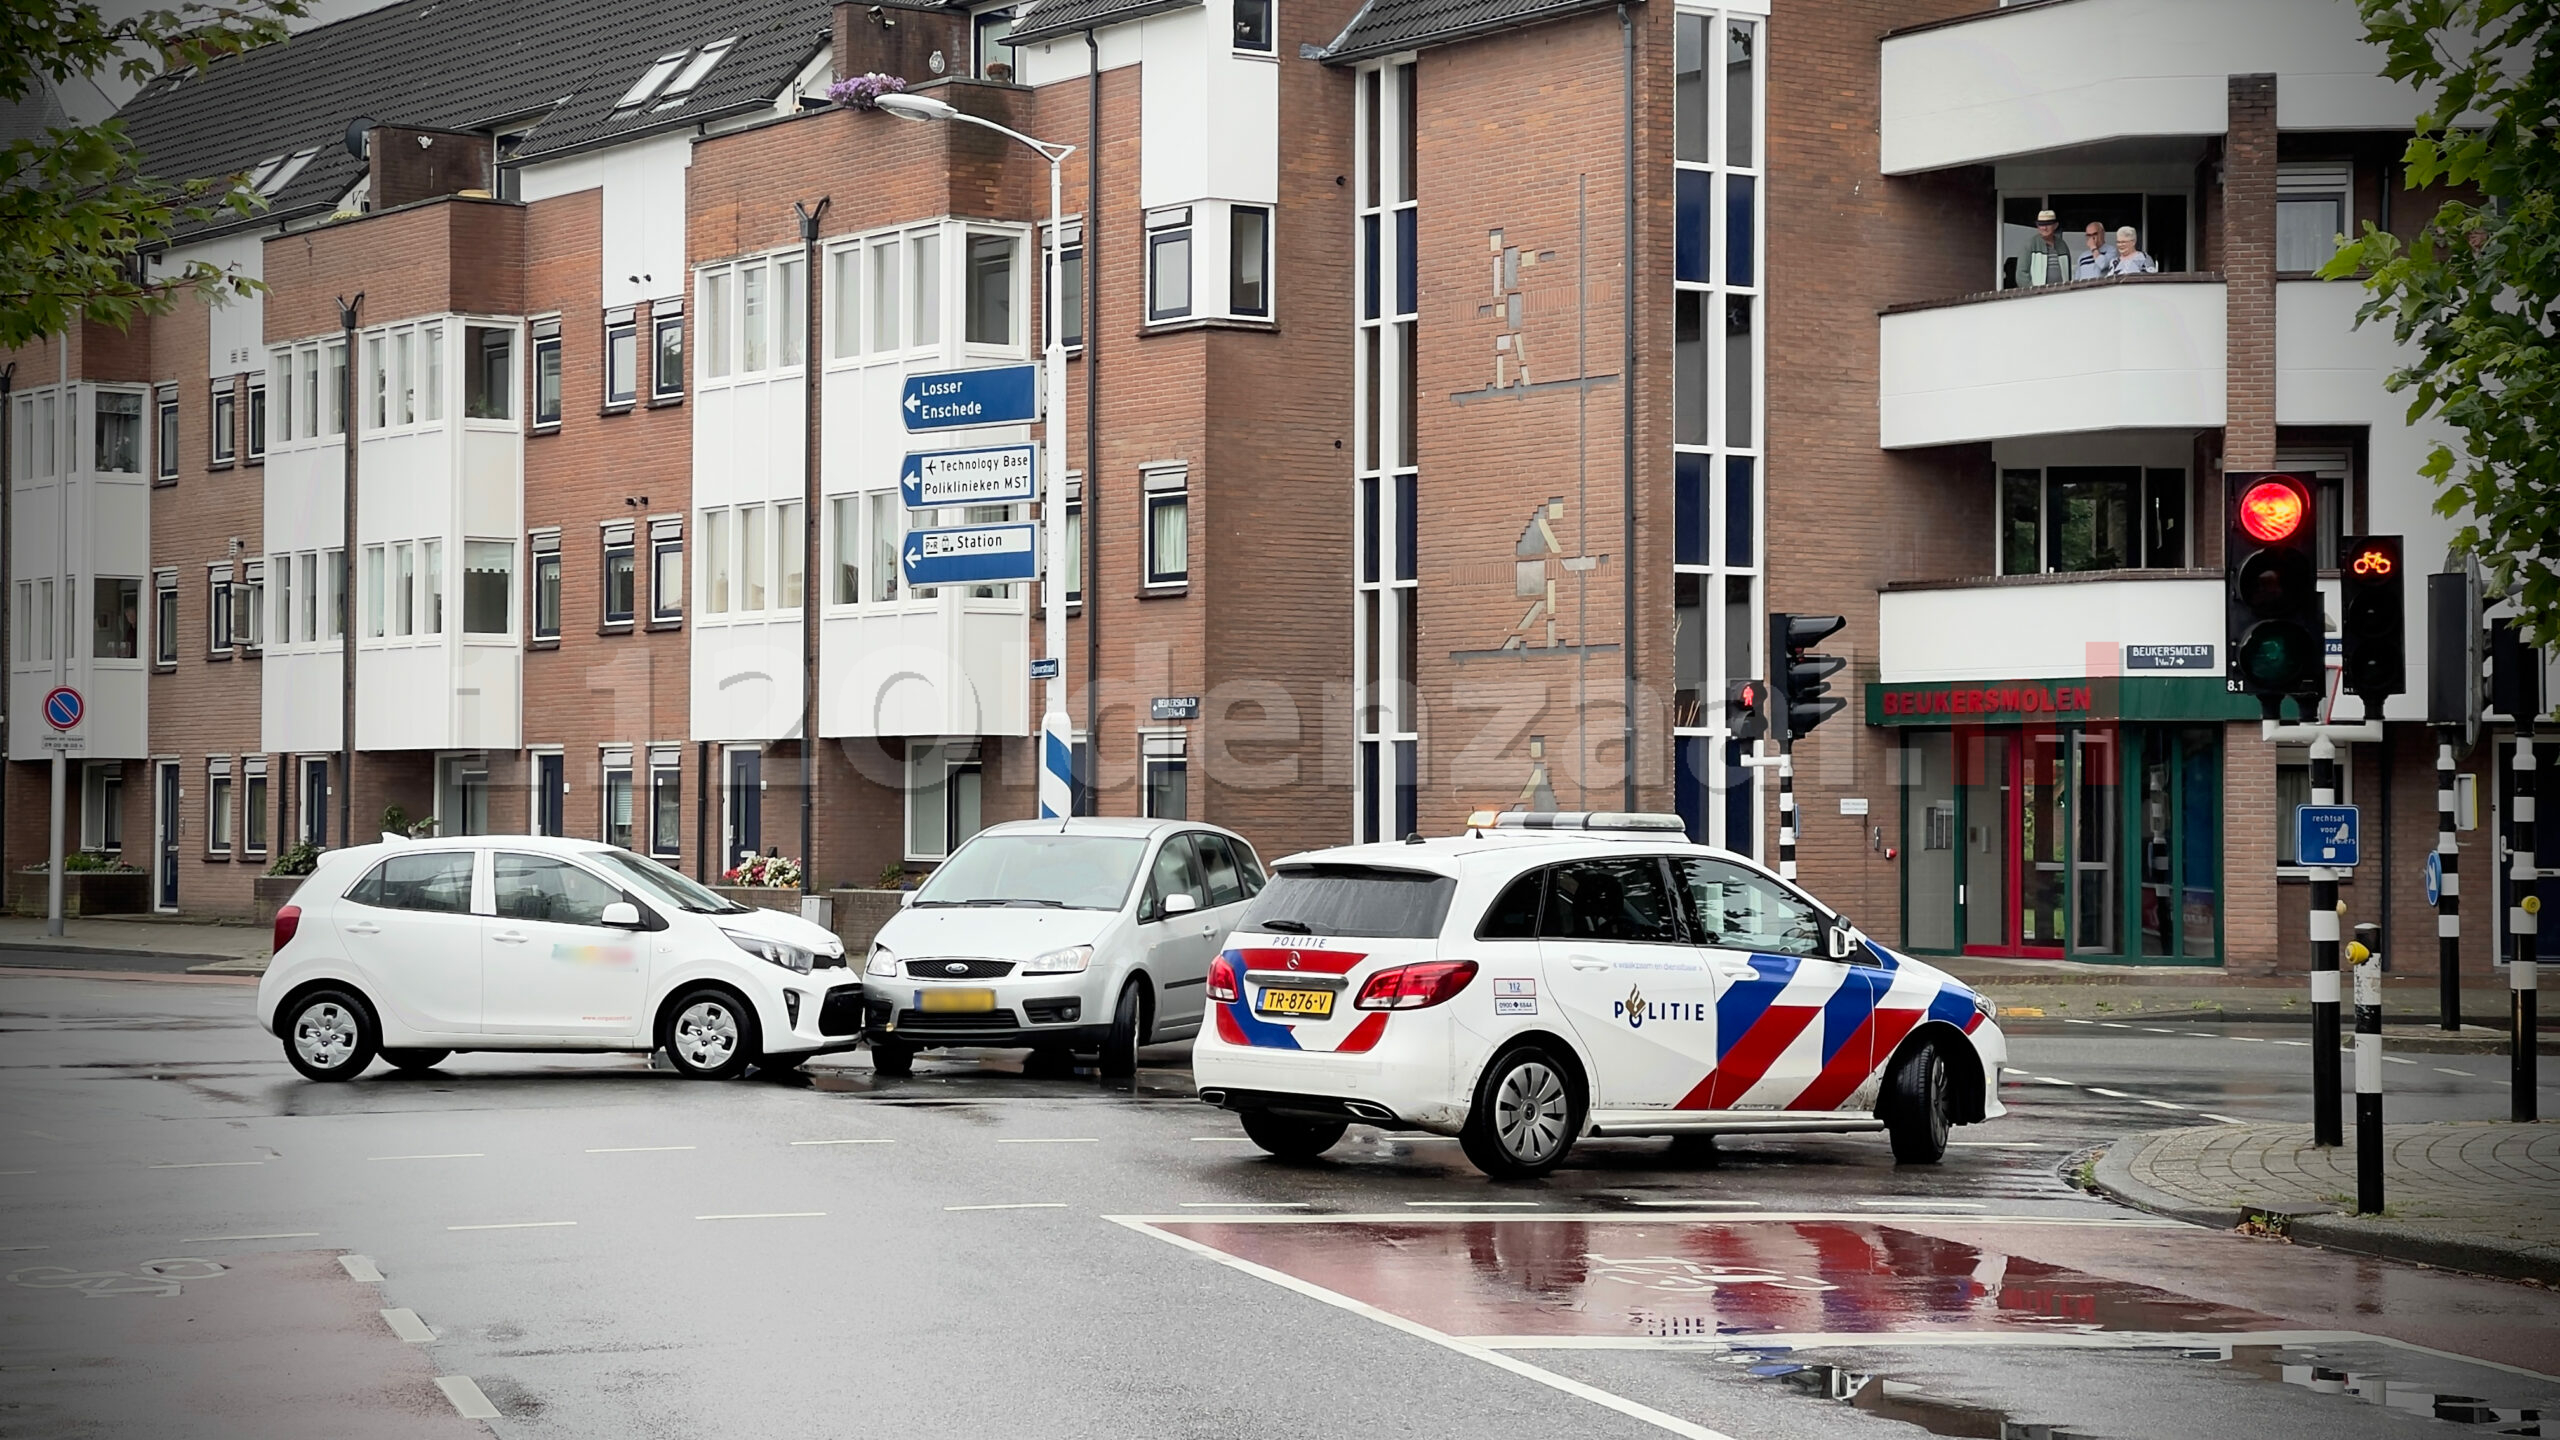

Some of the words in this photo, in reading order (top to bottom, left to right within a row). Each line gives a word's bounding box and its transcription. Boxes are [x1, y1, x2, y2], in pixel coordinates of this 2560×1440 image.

[921, 381, 963, 396] Losser
[922, 400, 982, 420] Enschede
[940, 458, 999, 472] Technology
[1003, 455, 1028, 467] Base
[924, 479, 1000, 495] Poliklinieken
[1004, 475, 1028, 489] MST
[957, 533, 1002, 549] Station
[2132, 646, 2208, 657] BEUKERSMOLEN
[2227, 680, 2244, 691] 8.1
[1883, 685, 2092, 716] BEUKERSMOLEN
[1272, 936, 1327, 948] POLITIE
[1509, 982, 1521, 991] 112
[1269, 992, 1327, 1010] TR-876-V
[1614, 1000, 1704, 1029] POLITIE
